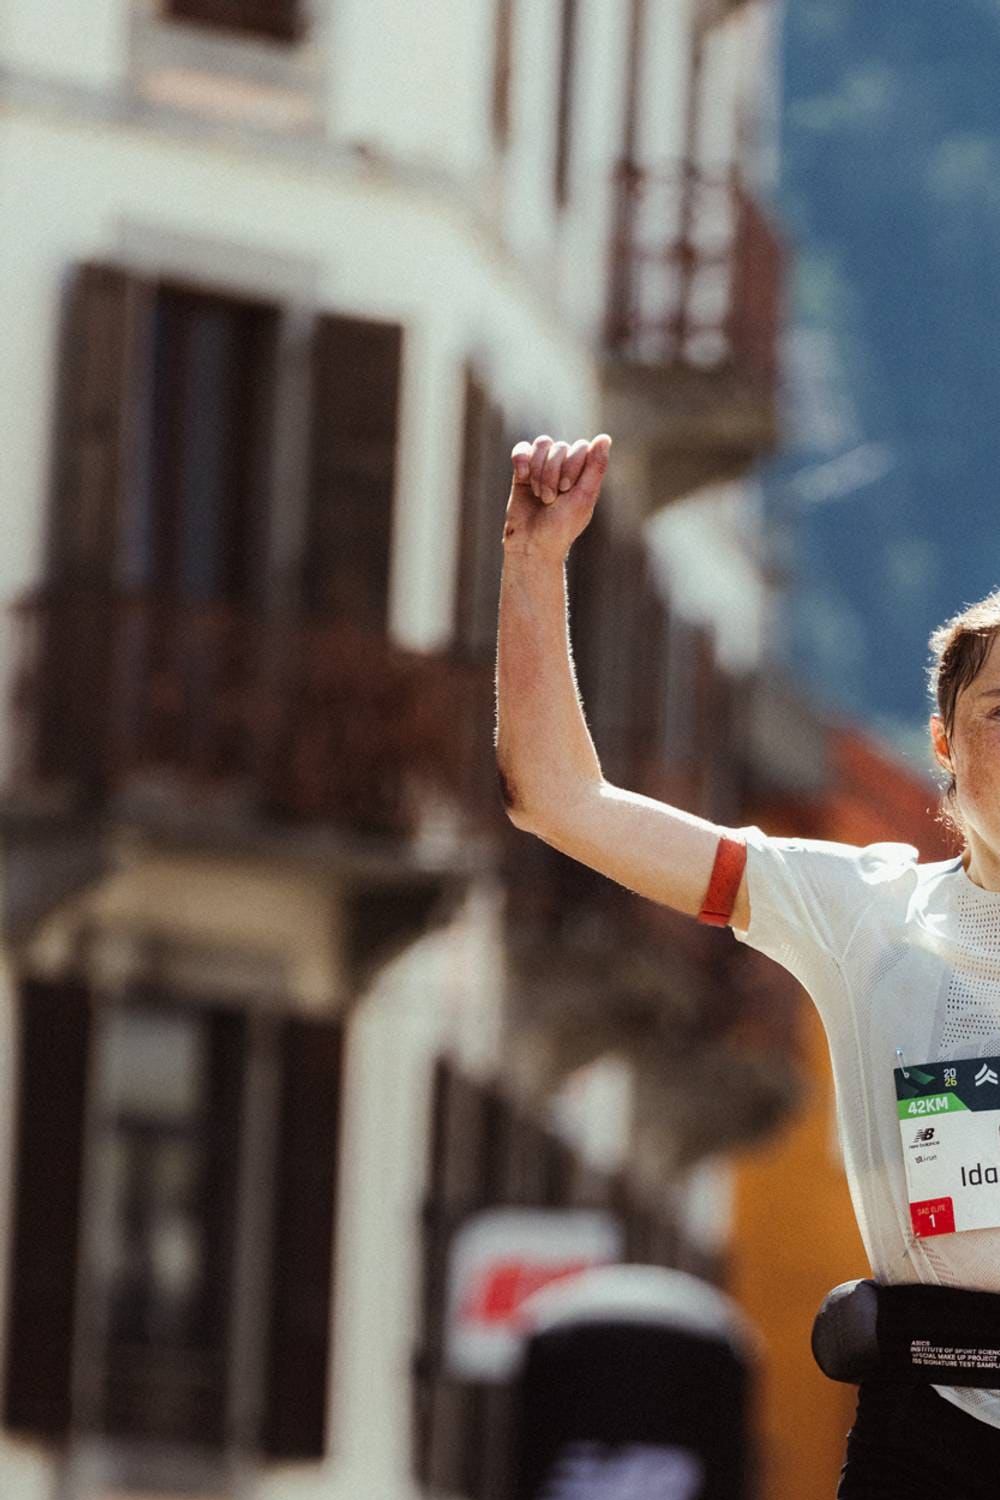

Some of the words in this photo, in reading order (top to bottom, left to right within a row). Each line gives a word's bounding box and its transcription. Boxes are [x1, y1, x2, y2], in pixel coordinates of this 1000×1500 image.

[943, 1068, 957, 1078] 20
[945, 1077, 958, 1087] 26
[908, 1096, 949, 1114] 42KM
[961, 1163, 998, 1187] Ida
[929, 1213, 936, 1228] 1
